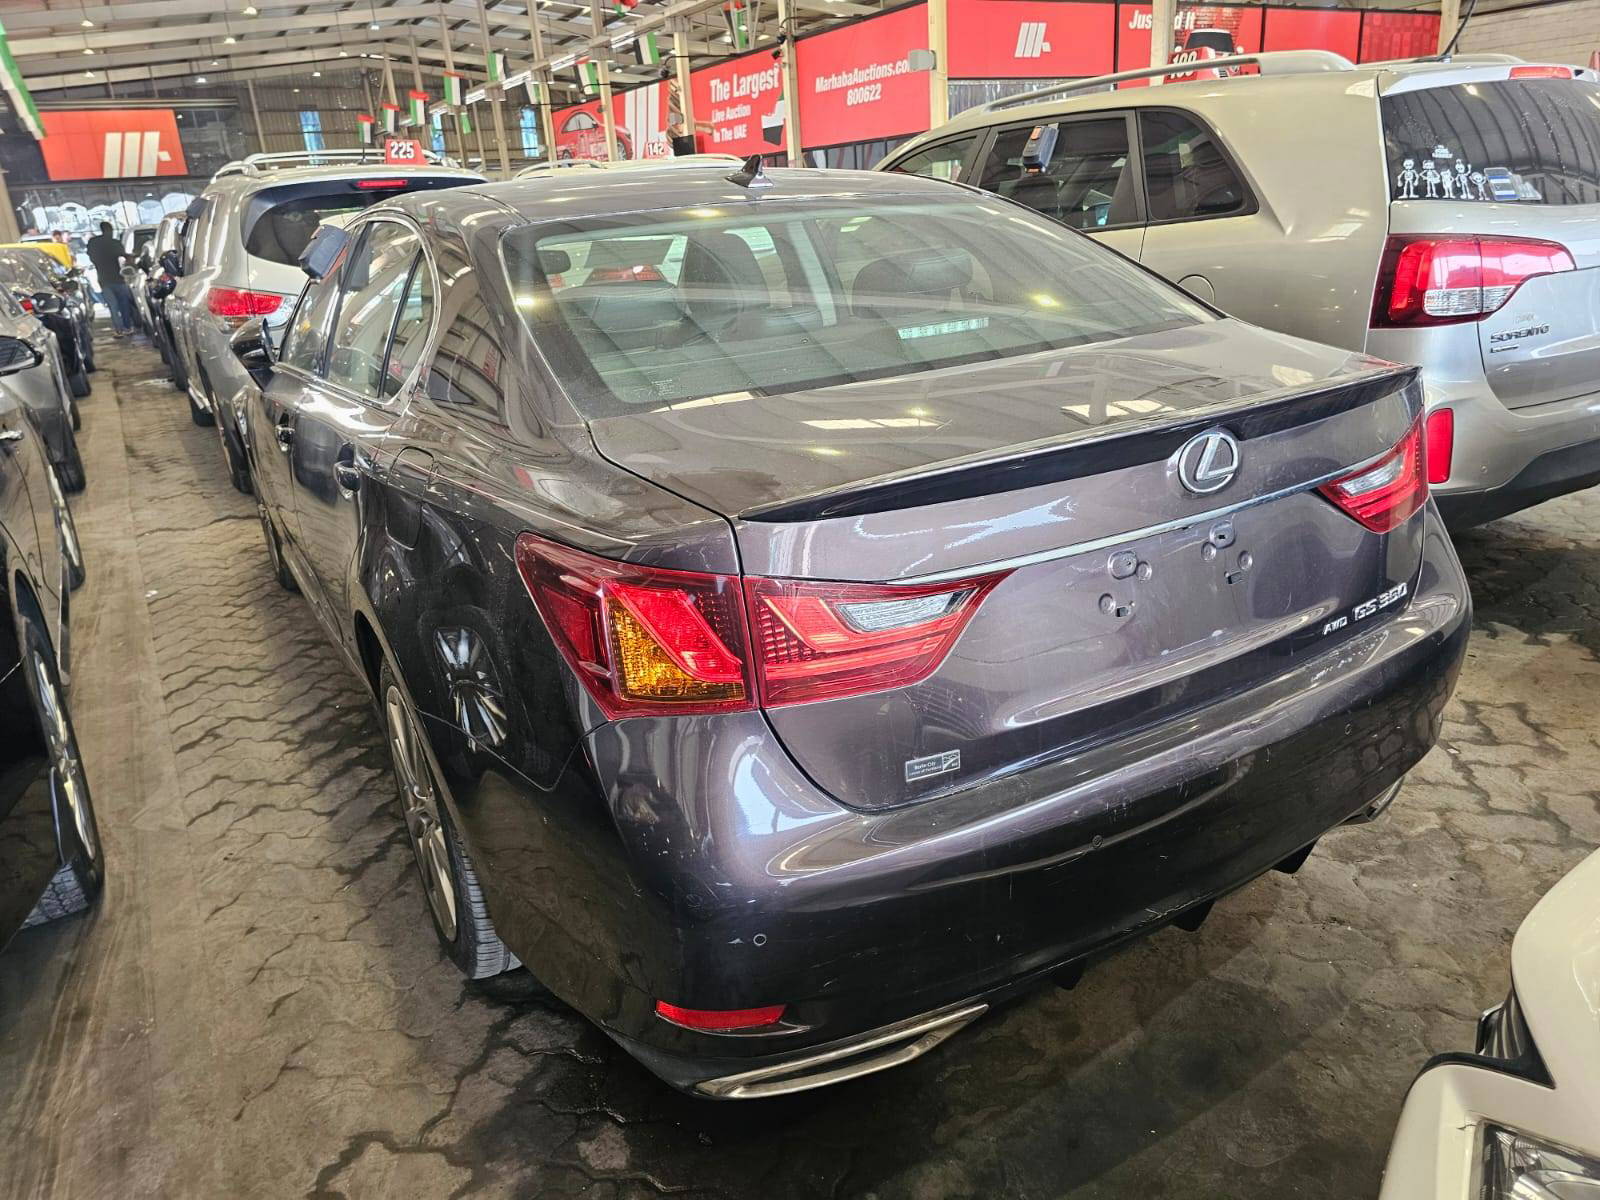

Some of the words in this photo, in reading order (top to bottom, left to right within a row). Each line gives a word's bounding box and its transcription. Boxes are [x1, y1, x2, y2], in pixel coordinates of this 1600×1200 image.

[1128, 10, 1152, 29] Jus
[710, 78, 730, 103] The
[733, 62, 779, 99] Largest
[815, 59, 911, 93] MarhabaAuctions.co
[846, 82, 882, 106] 800622
[712, 109, 725, 123] Live
[726, 103, 752, 121] Auction
[721, 127, 733, 142] The
[390, 141, 414, 159] 225
[647, 142, 665, 156] 142
[1490, 324, 1550, 344] SORENTO
[1322, 616, 1348, 636] AWD
[1352, 598, 1378, 621] GS
